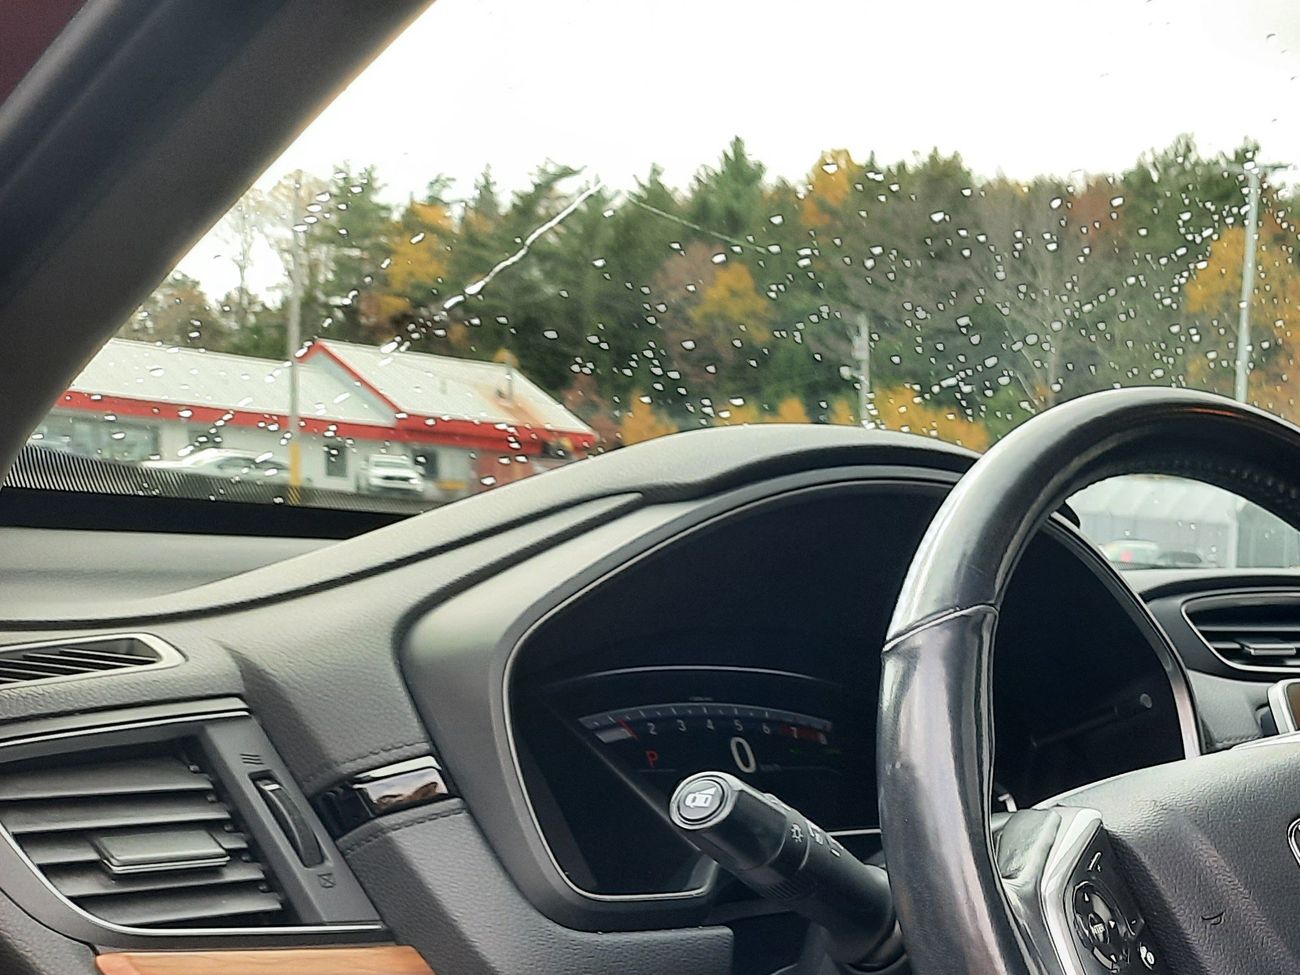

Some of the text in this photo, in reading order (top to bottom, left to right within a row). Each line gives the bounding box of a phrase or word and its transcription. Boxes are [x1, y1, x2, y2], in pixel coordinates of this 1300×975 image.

[677, 719, 687, 732] 3
[734, 719, 744, 732] 5
[645, 750, 659, 767] P
